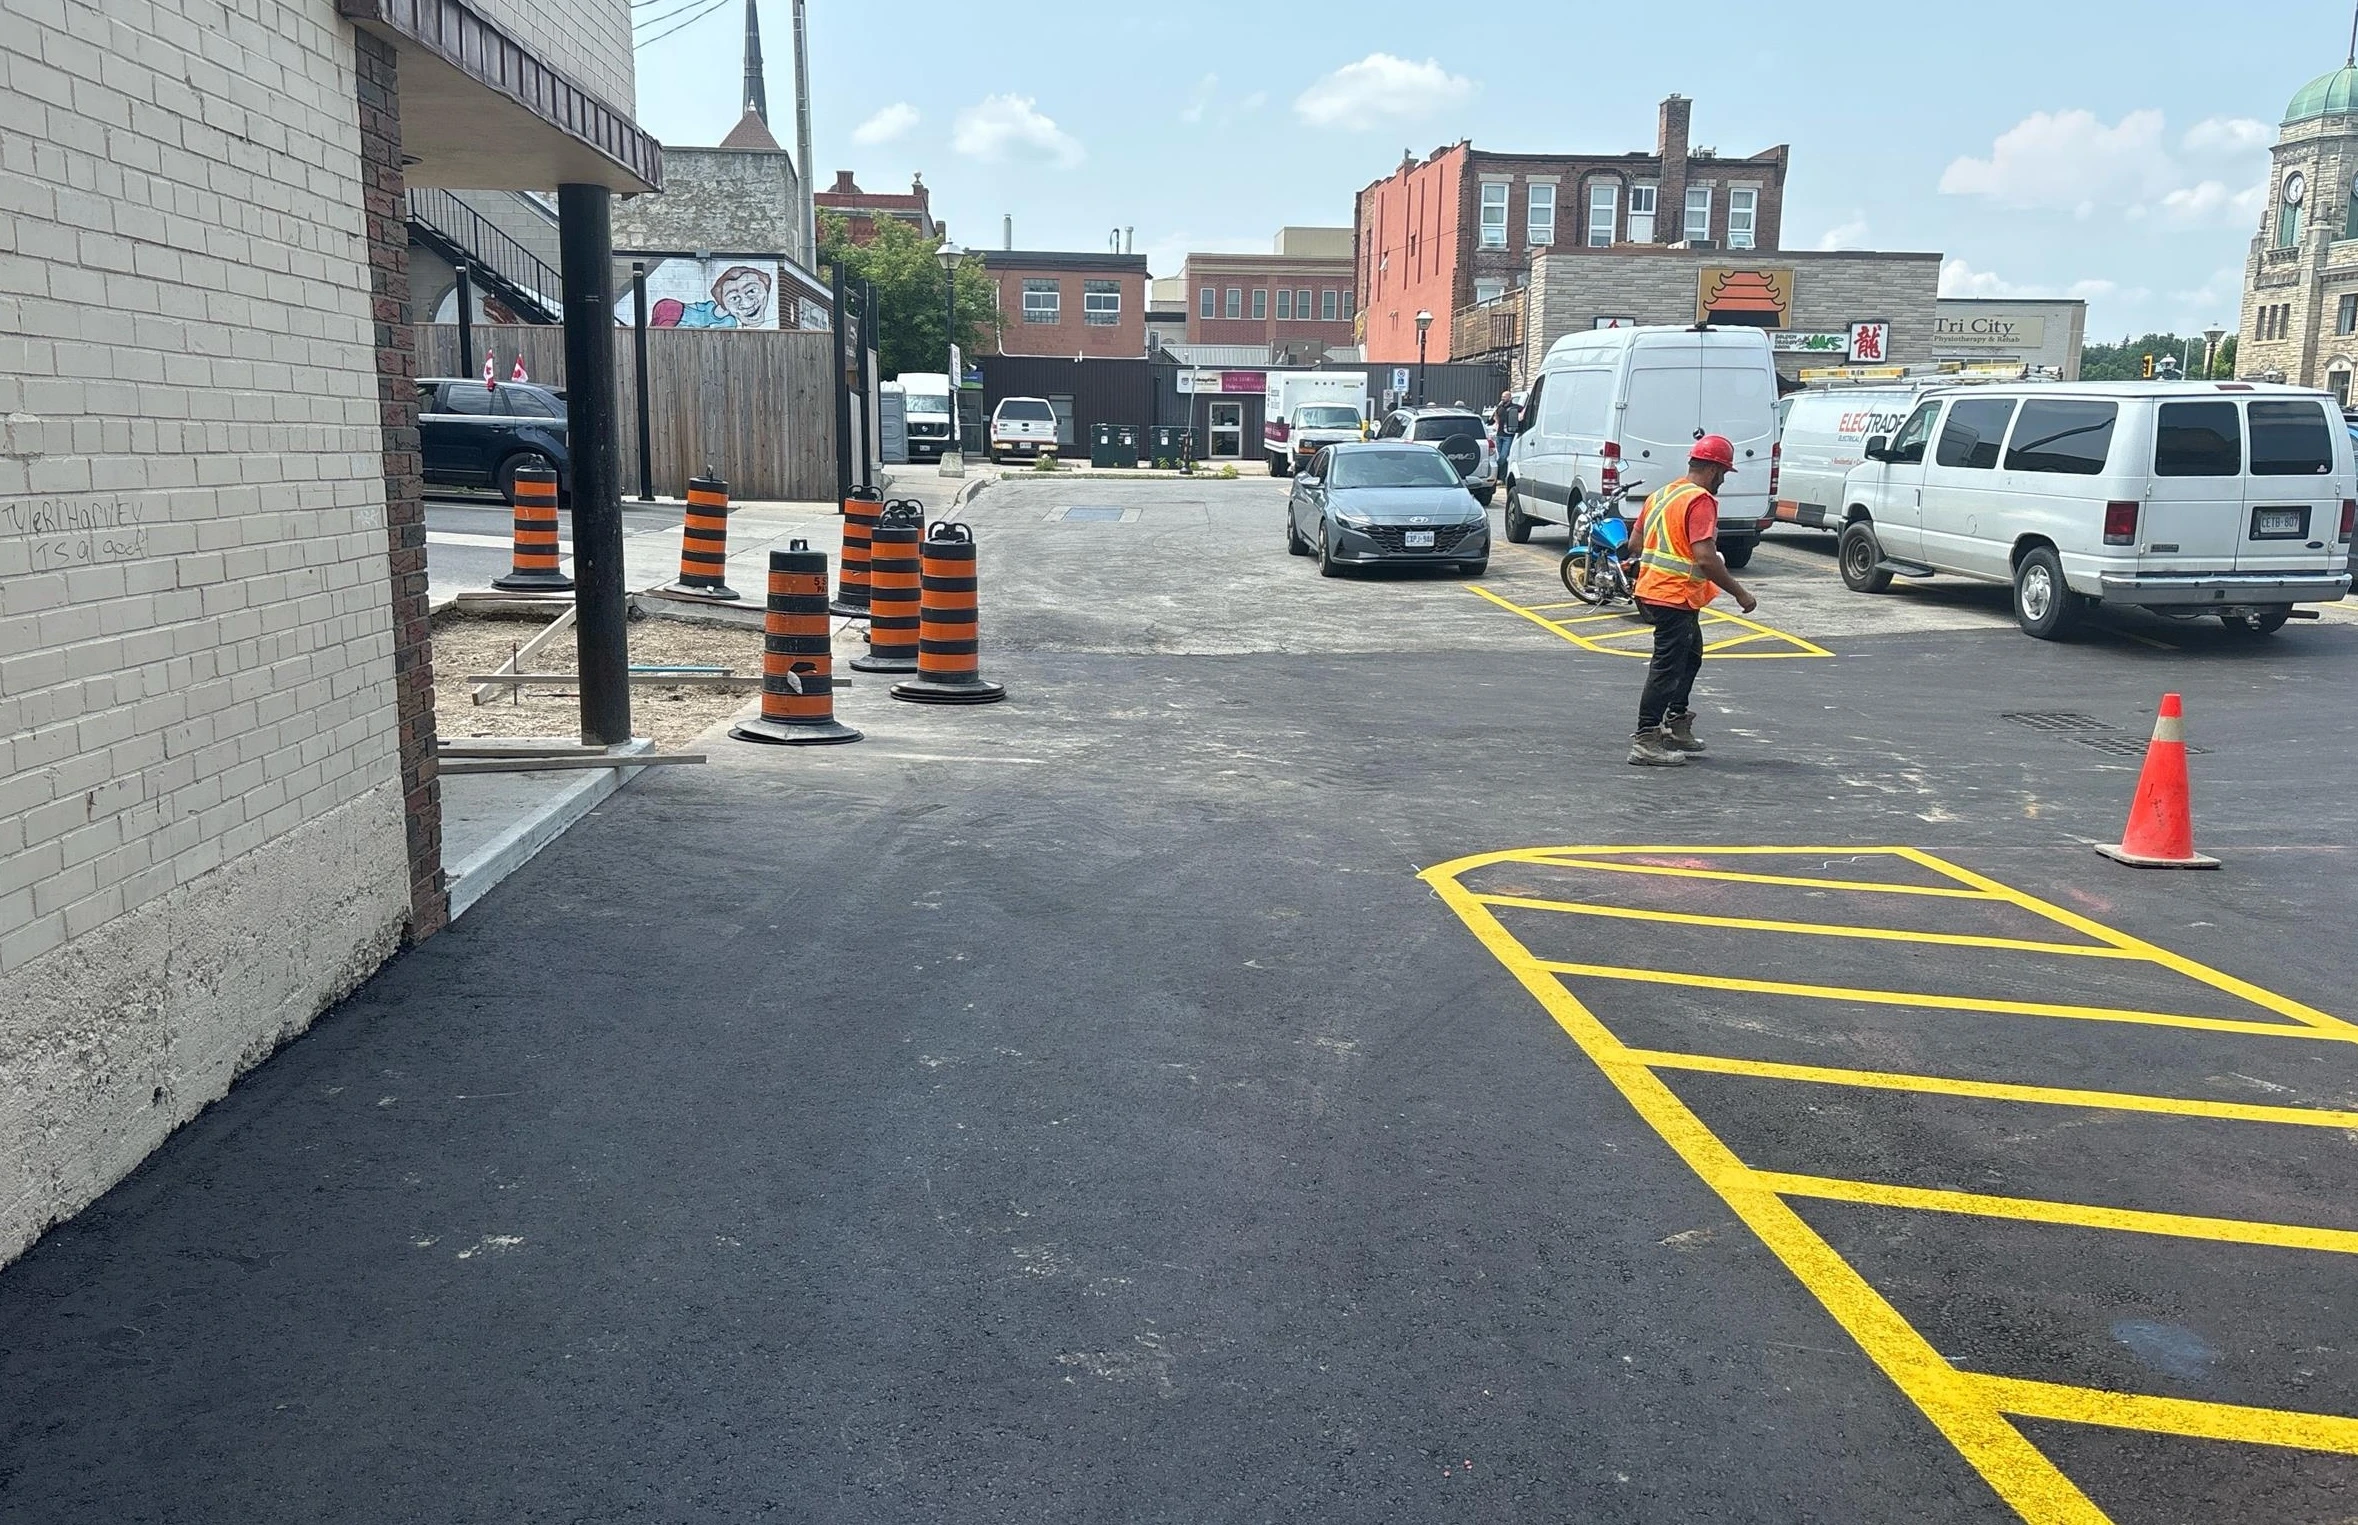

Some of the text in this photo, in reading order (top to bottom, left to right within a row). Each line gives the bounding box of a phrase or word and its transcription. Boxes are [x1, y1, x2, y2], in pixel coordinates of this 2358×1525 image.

[1934, 318, 2015, 337] Tri City
[1854, 325, 1882, 359] 龍
[1934, 335, 1986, 343] Physiotherapy
